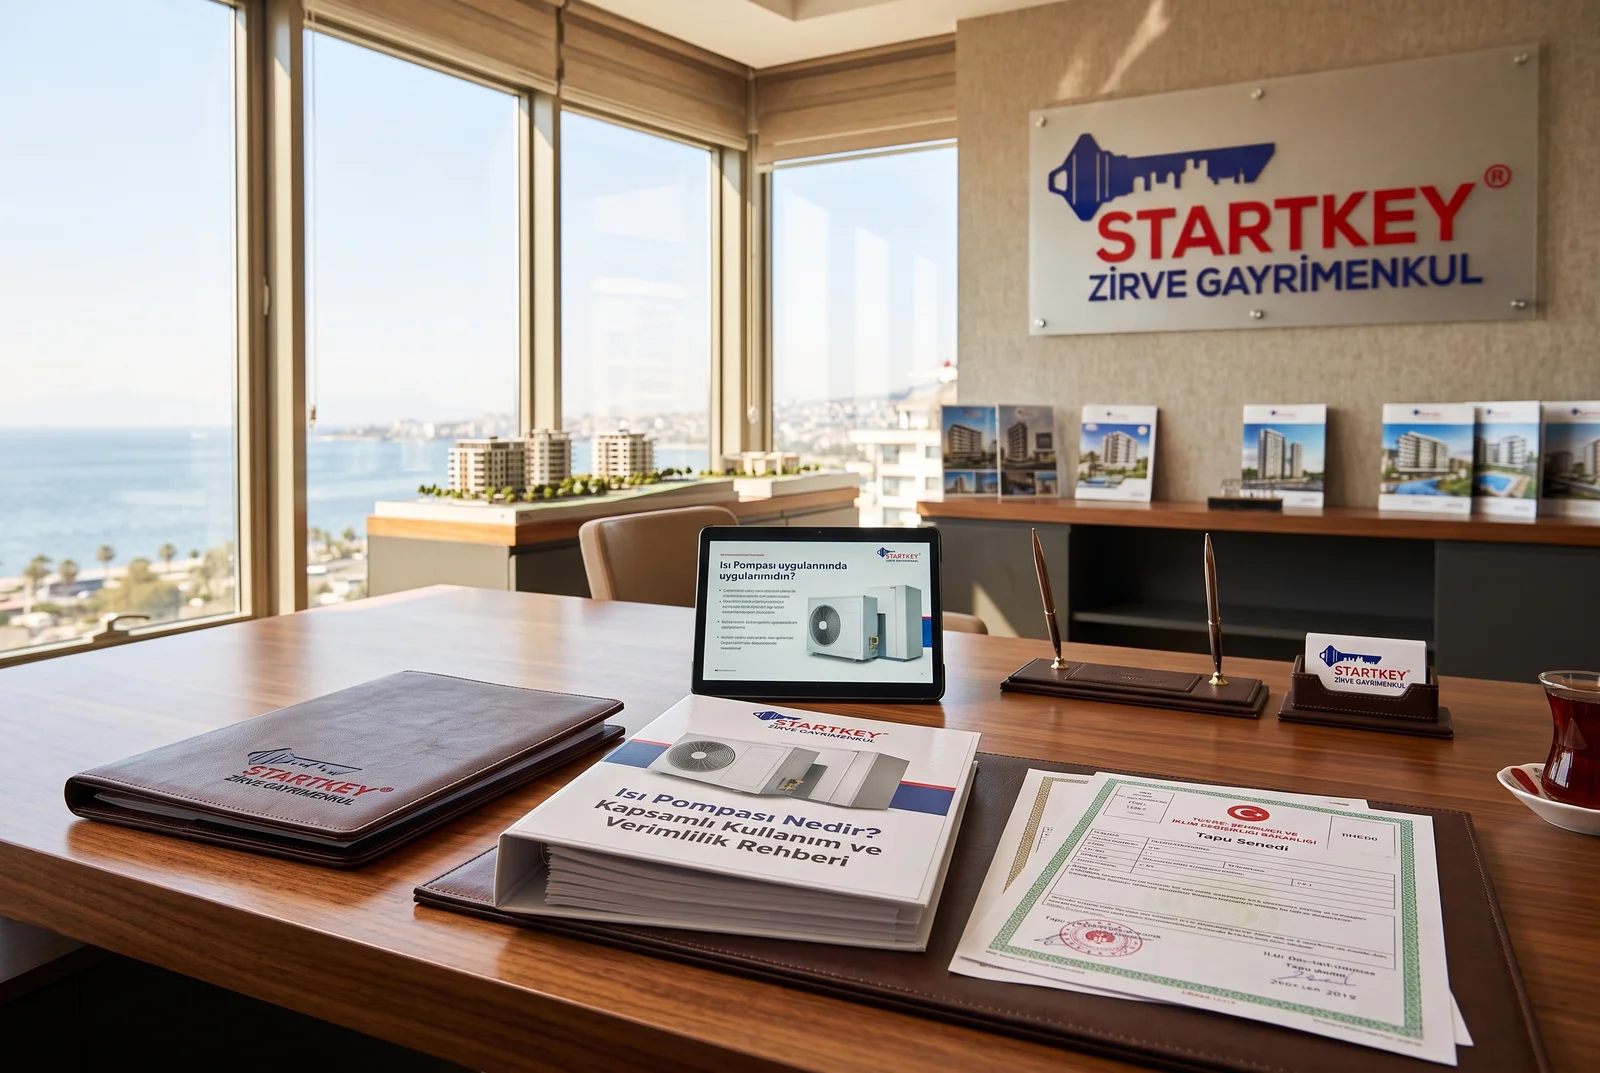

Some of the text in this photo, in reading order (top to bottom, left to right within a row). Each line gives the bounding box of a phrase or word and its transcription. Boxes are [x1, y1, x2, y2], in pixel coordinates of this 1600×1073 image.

[1096, 182, 1476, 263] STARTKEY
[1088, 253, 1484, 302] ZİRVE GAYRİMENKUL
[720, 561, 731, 569] Isı
[733, 561, 776, 571] Pompası
[1334, 665, 1407, 681] STARTKEY
[773, 720, 883, 738] STARTKEY
[242, 765, 379, 796] STARTKEY
[594, 799, 882, 856] Kapsamlı Kullanım ve
[615, 787, 882, 839] Isı Pompası Nedir?
[606, 816, 850, 867] Verimlilik Rehberi
[1196, 832, 1289, 852] Tapu Senedi
